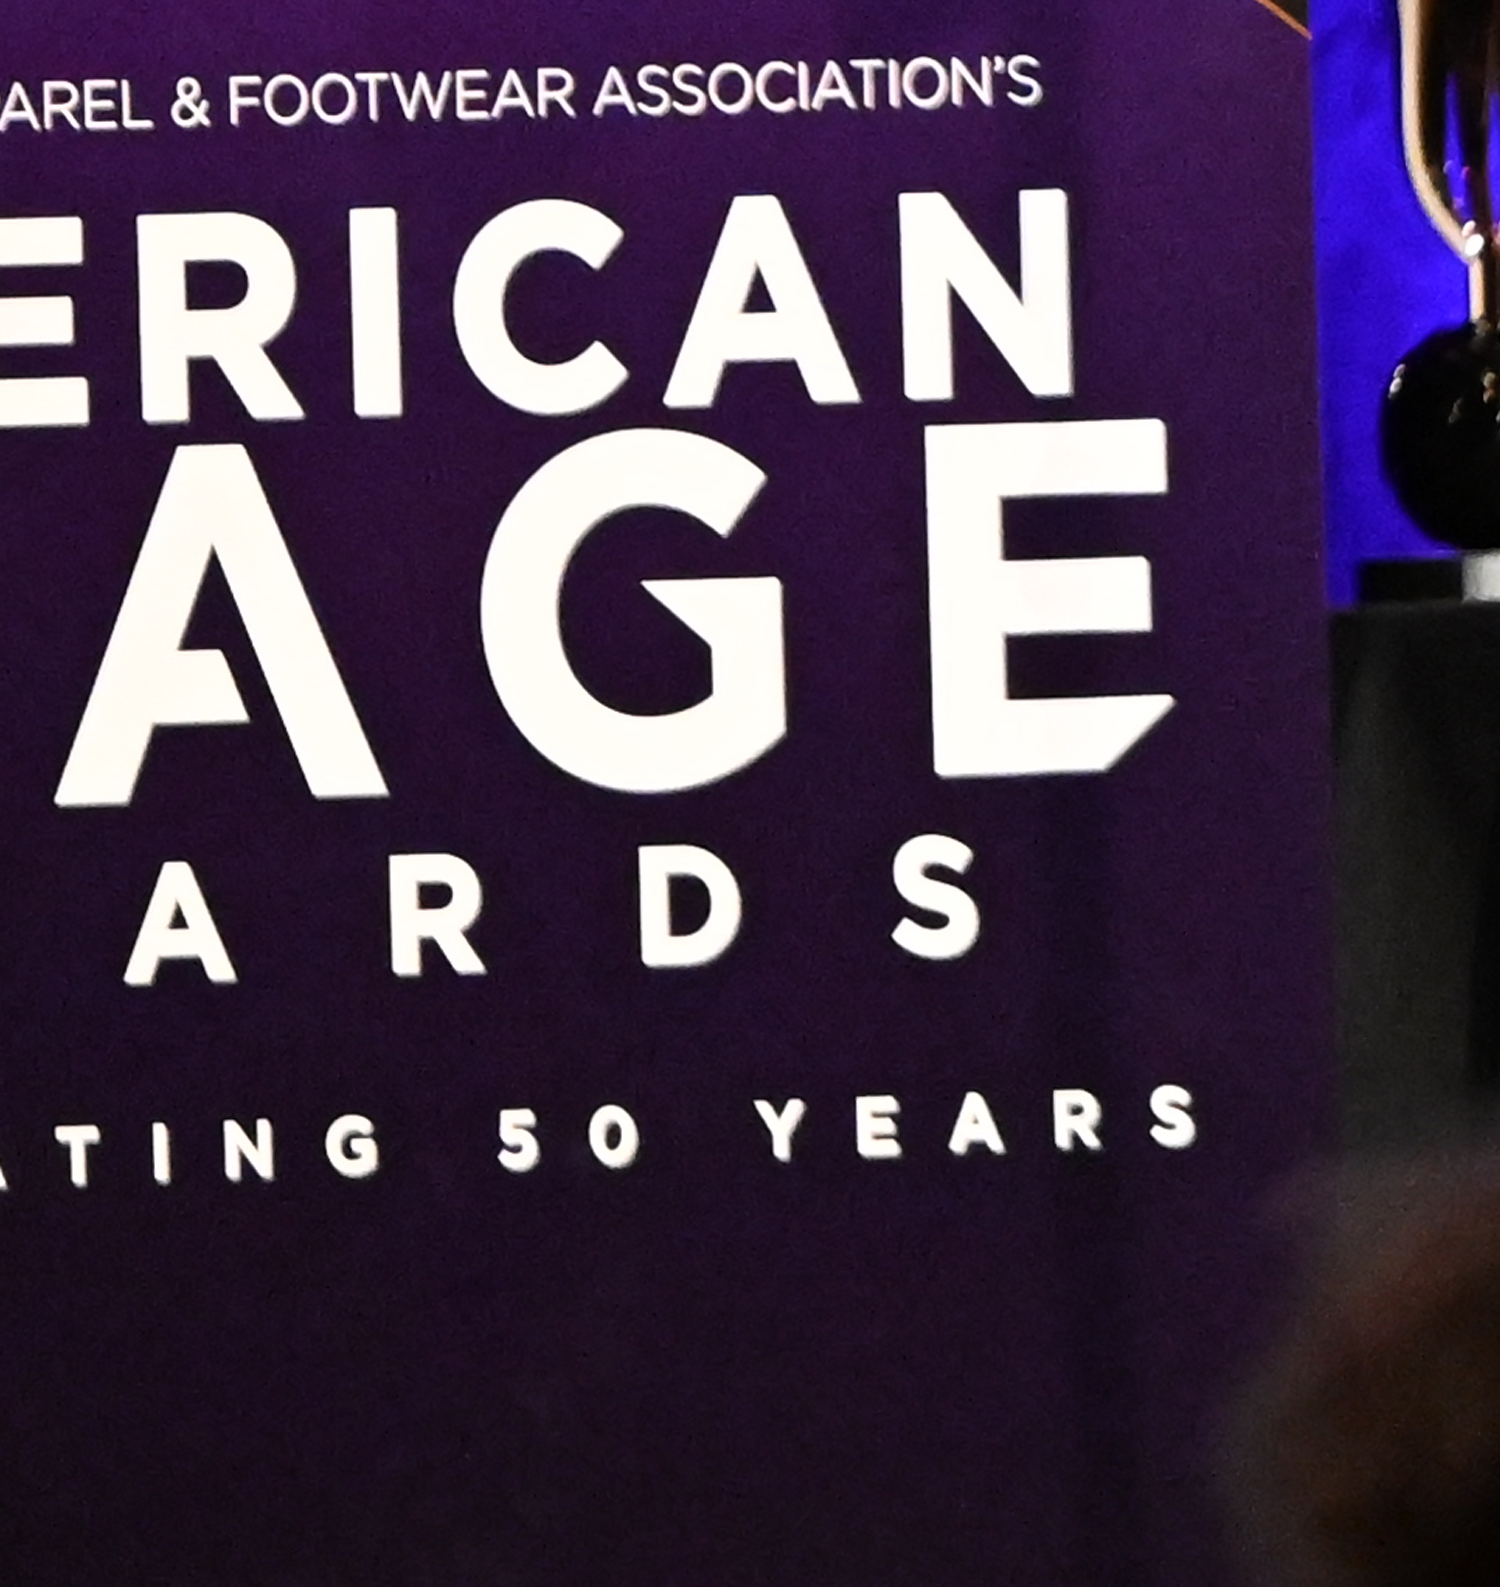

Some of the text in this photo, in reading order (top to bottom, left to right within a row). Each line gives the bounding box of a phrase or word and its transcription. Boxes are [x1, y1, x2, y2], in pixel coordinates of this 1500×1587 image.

[170, 76, 212, 129] &
[228, 67, 577, 128] FOOTWEAR
[592, 54, 1044, 117] ASSOCIATION'S
[497, 1104, 640, 1173] 50
[753, 1084, 1197, 1163] YEARS
